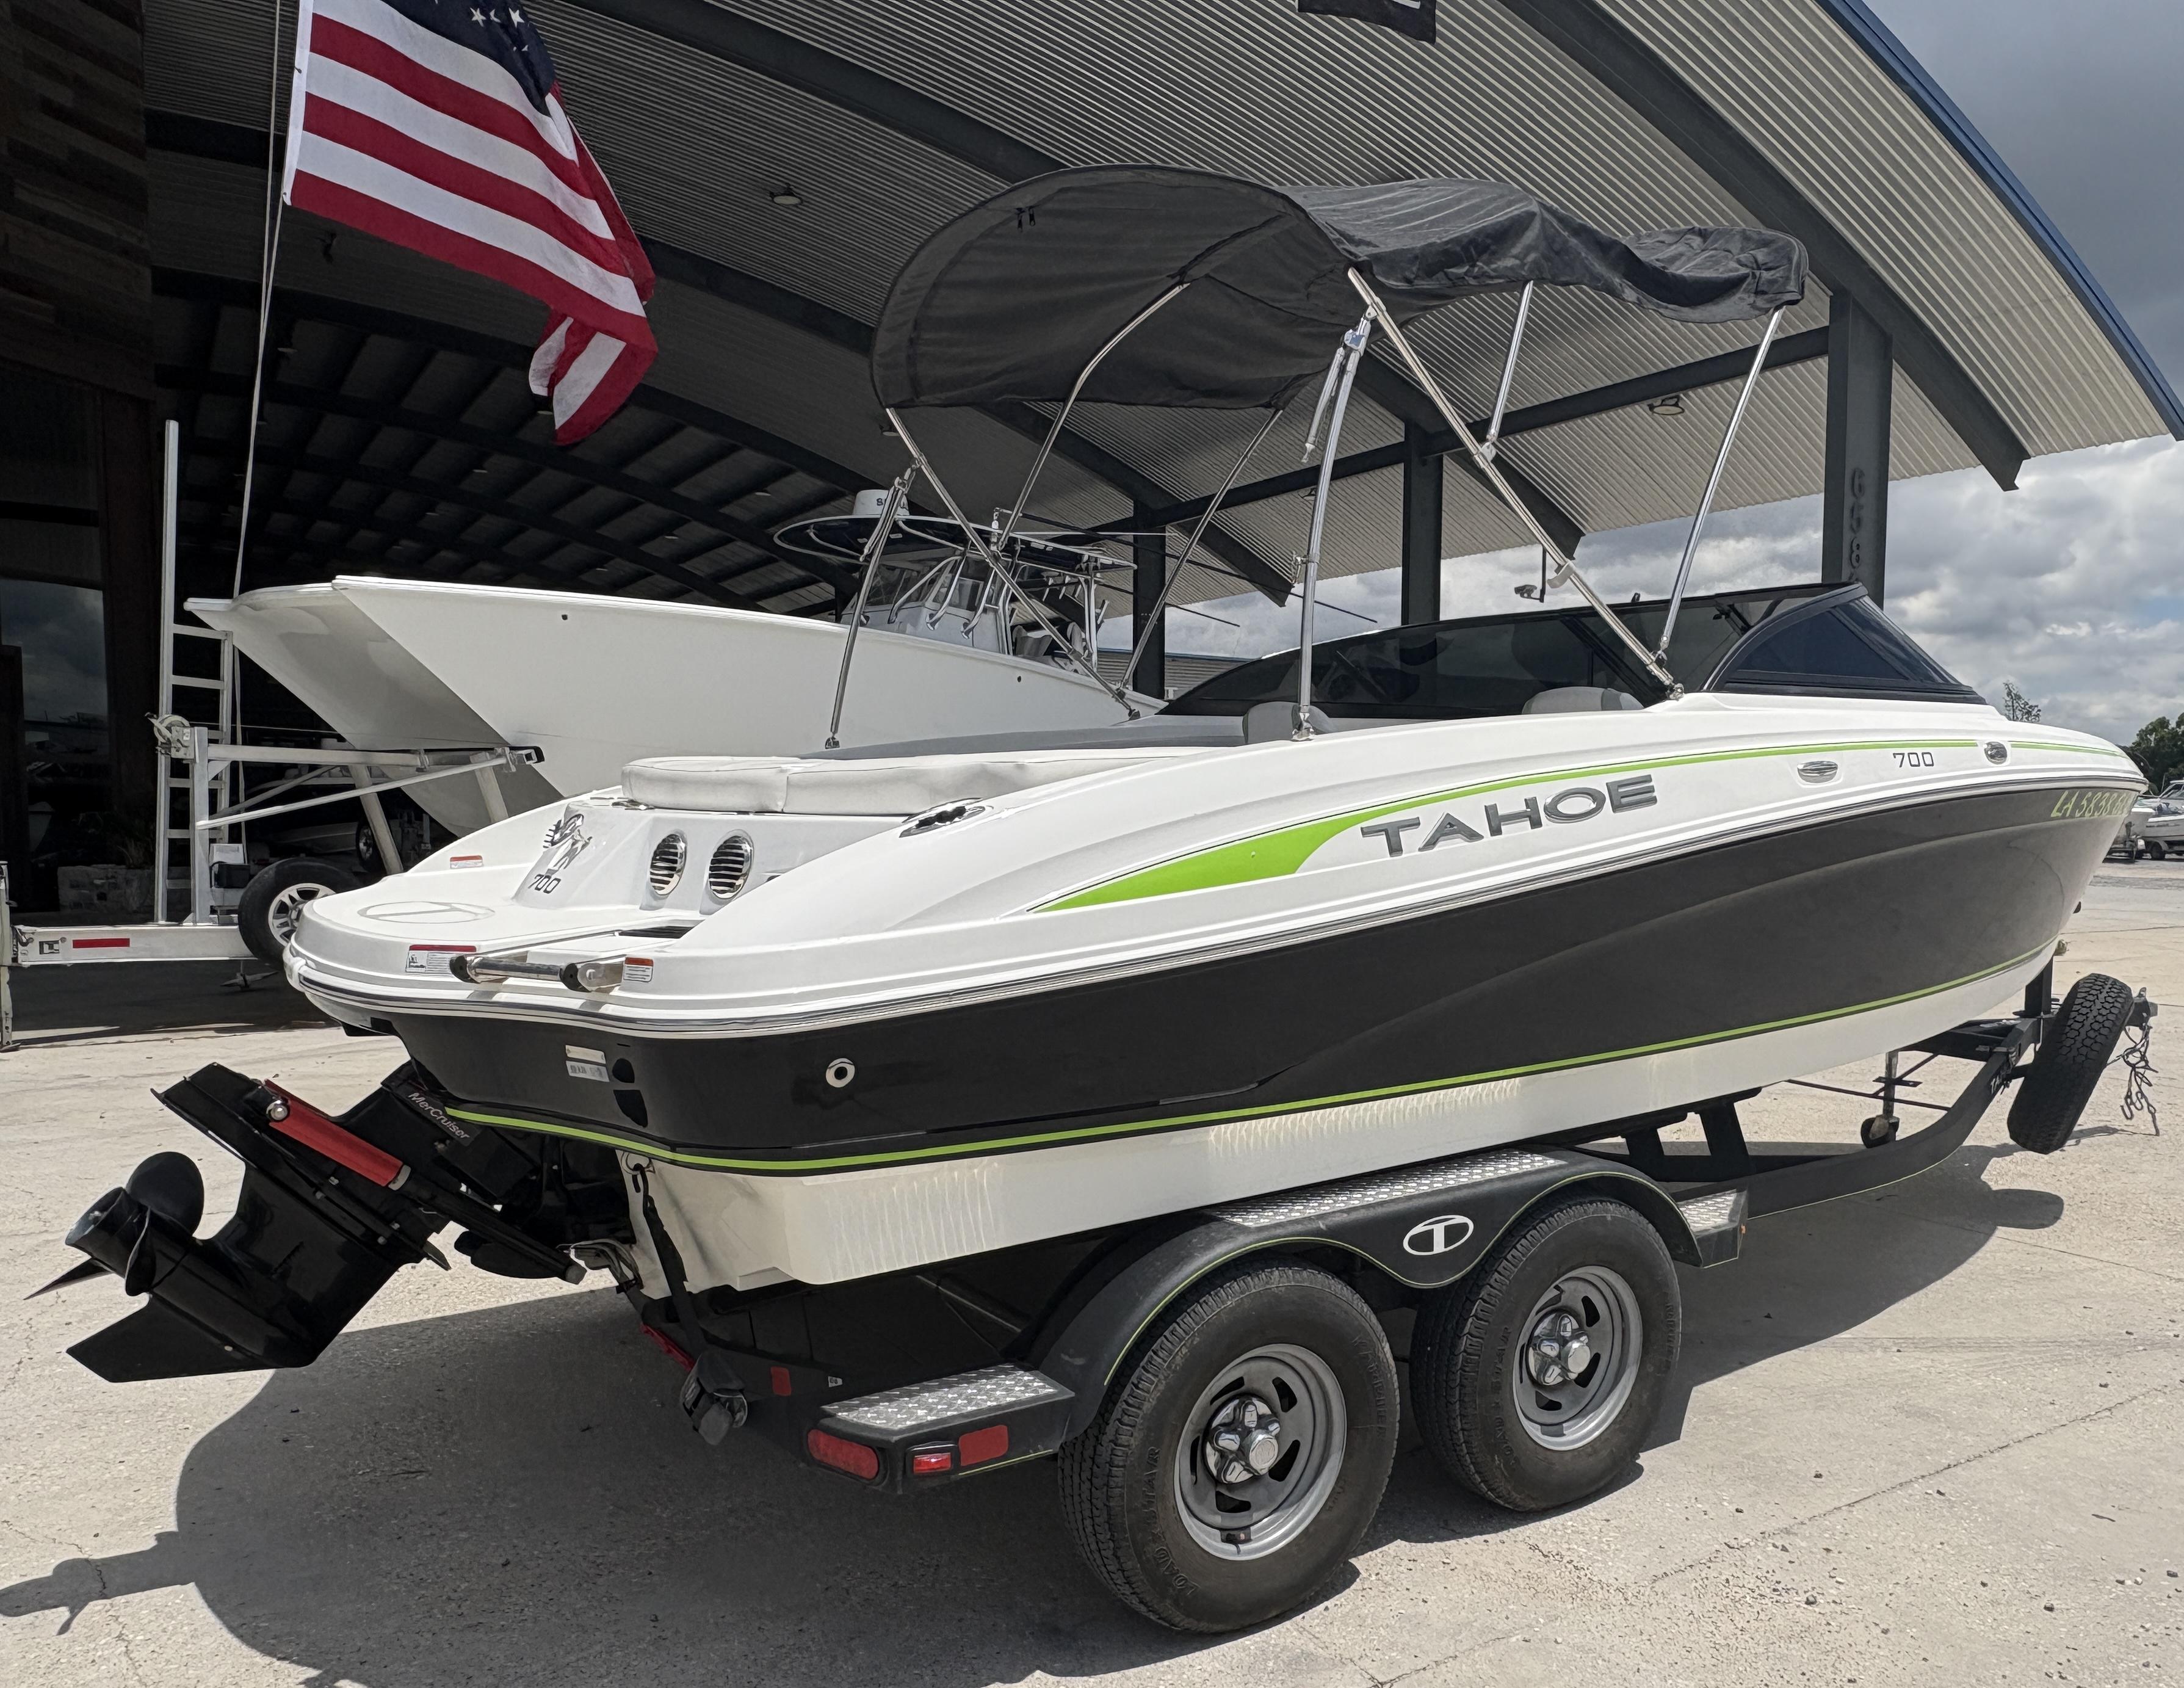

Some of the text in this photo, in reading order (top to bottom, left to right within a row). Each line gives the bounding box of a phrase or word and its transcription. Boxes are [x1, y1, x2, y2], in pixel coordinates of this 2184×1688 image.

[1892, 752, 1934, 768] 700
[1360, 774, 1658, 858] TAHOE
[2050, 790, 2080, 817] LA
[528, 874, 562, 894] 700
[408, 1092, 470, 1139] MerCruiser
